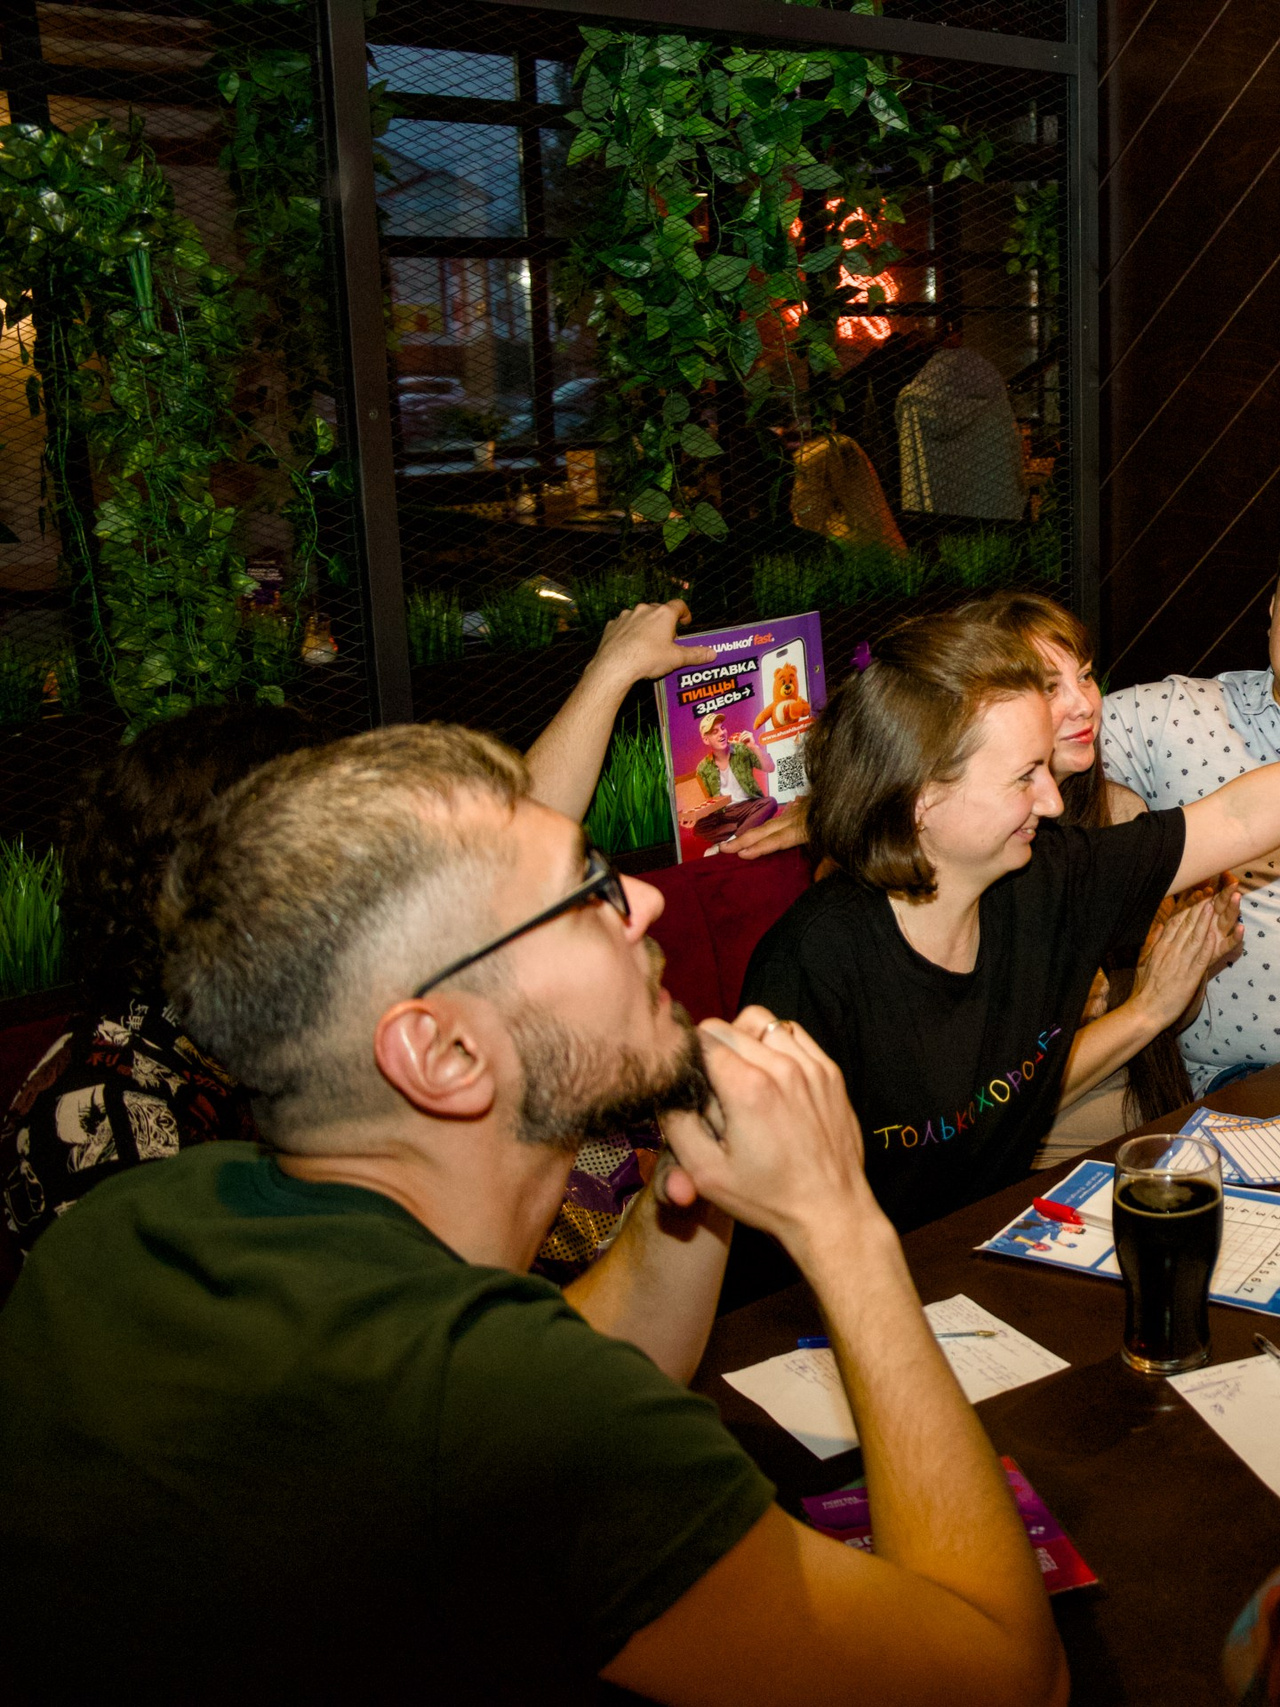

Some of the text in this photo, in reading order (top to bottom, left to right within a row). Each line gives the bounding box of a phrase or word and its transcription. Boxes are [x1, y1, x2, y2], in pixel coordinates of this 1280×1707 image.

[680, 660, 757, 688] ДОСТАВКА
[682, 678, 736, 703] ПИЦЦЫ
[696, 691, 742, 715] ЗДЕСЬ
